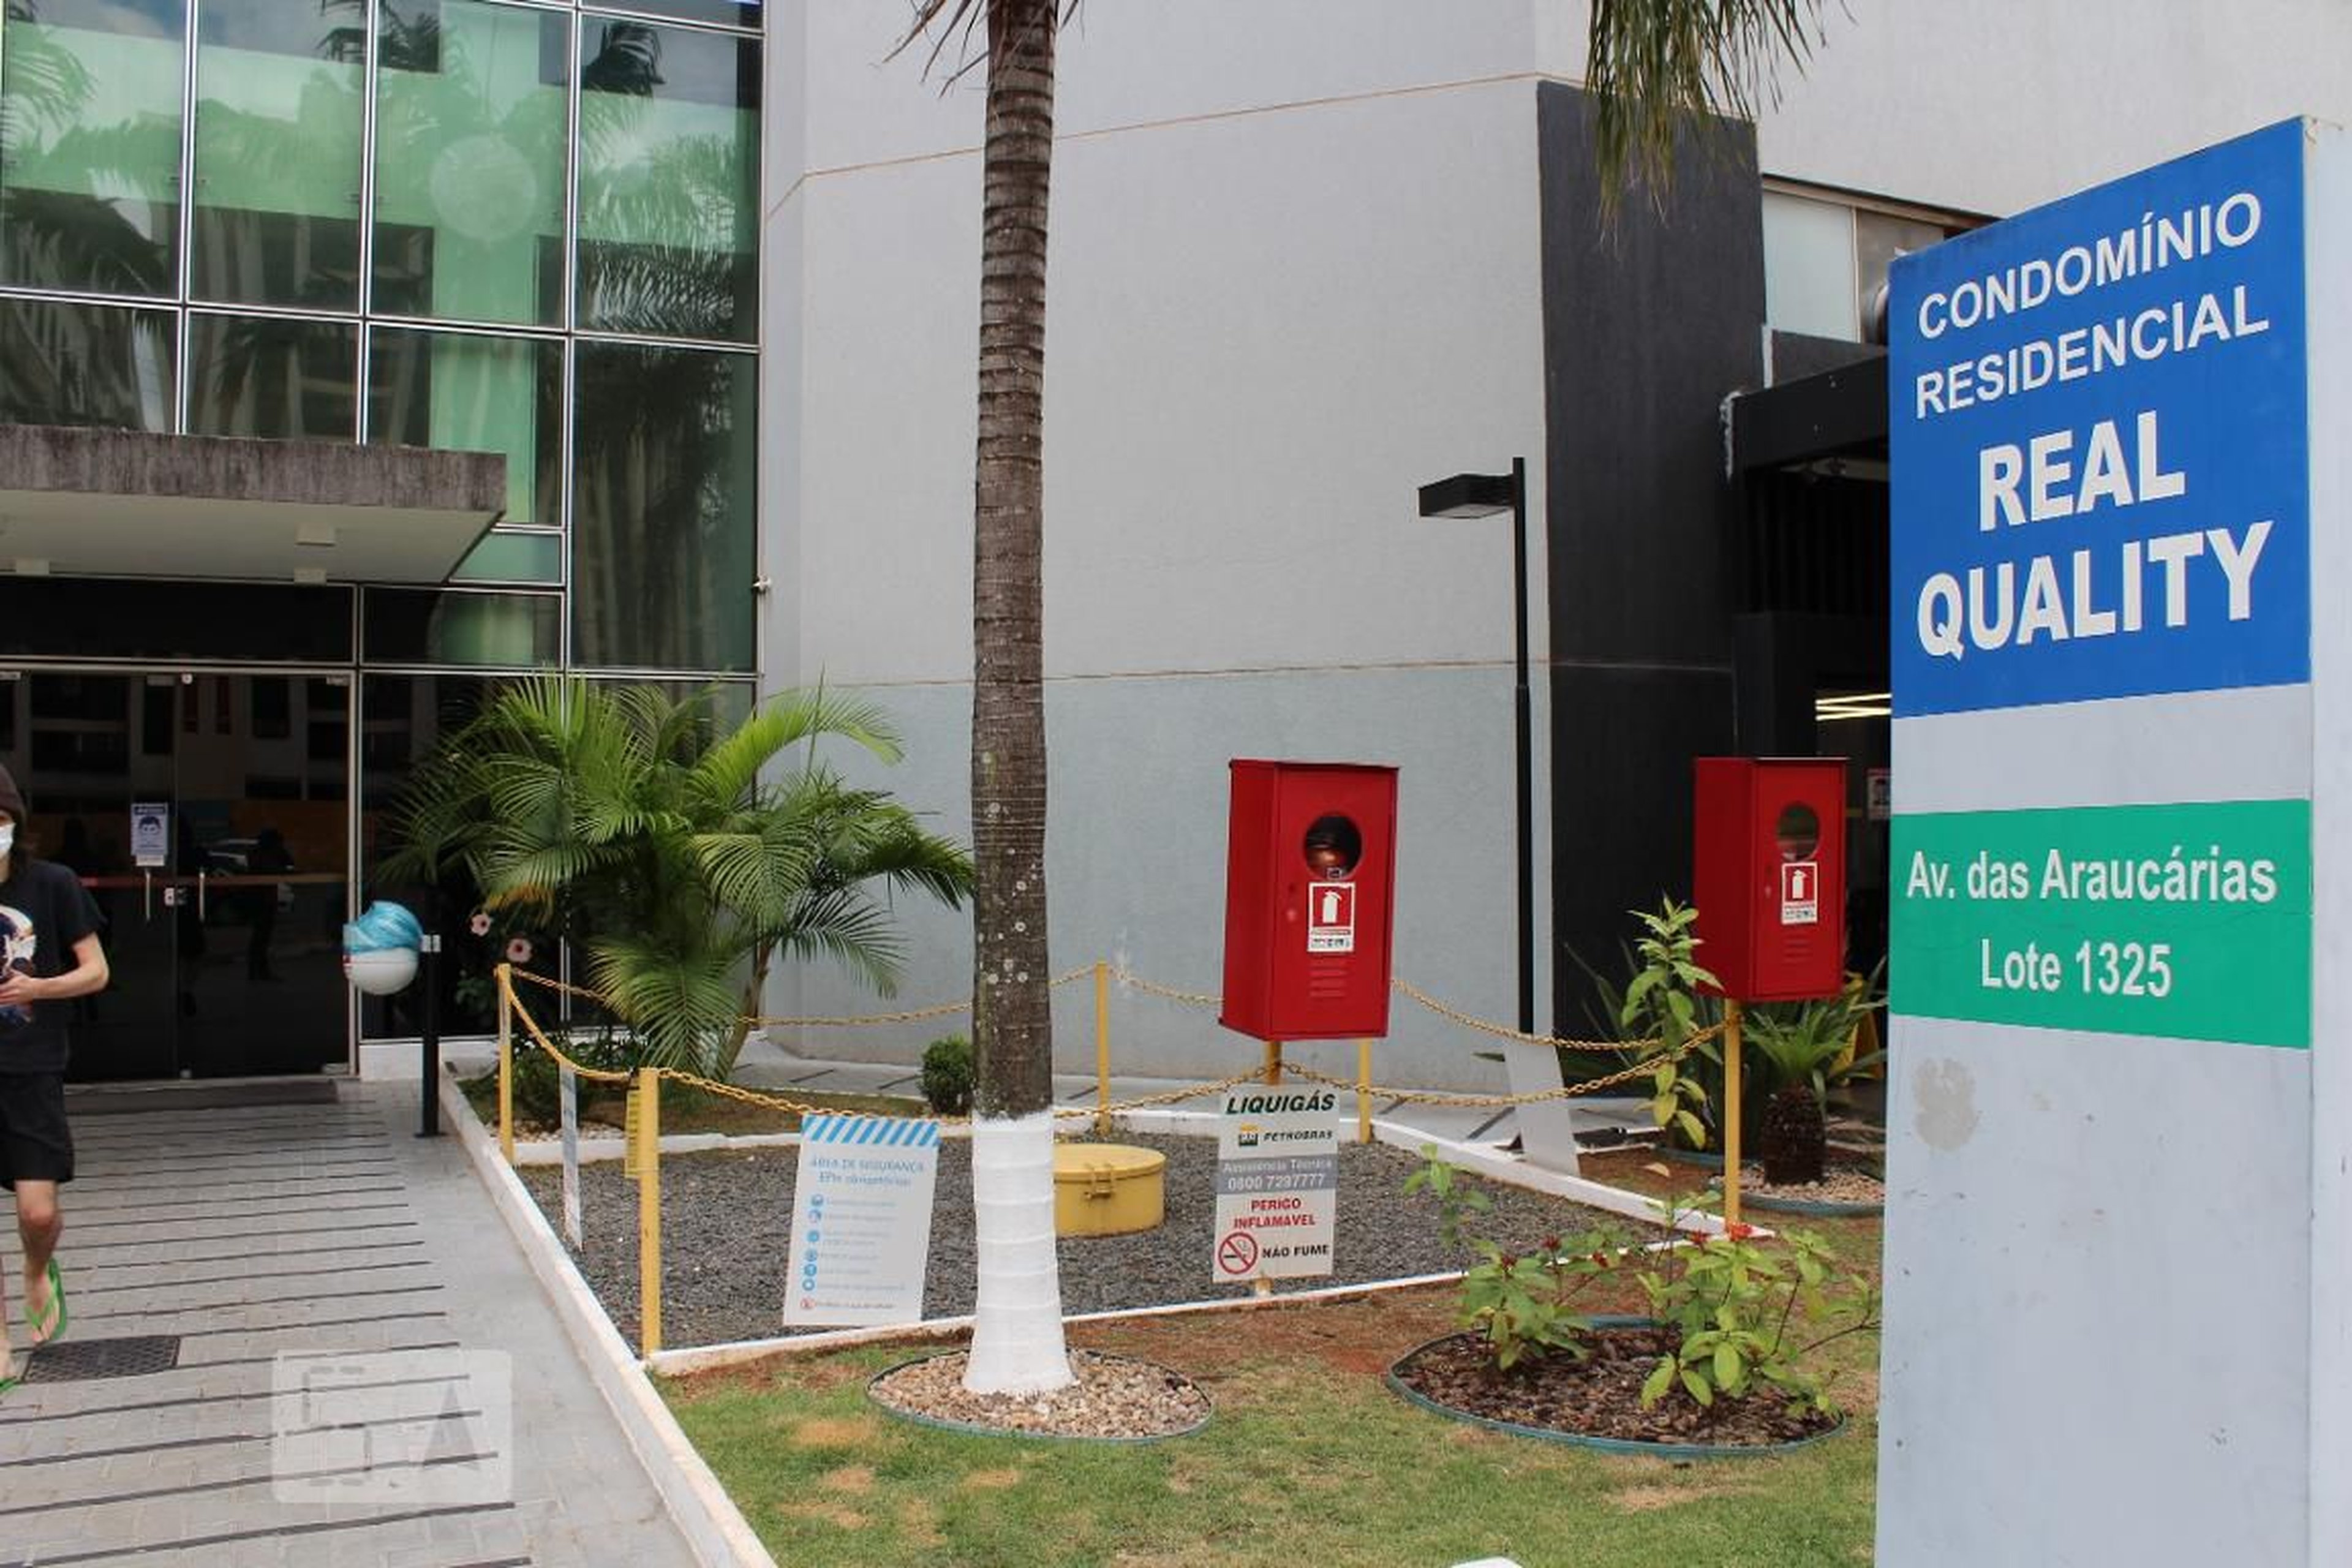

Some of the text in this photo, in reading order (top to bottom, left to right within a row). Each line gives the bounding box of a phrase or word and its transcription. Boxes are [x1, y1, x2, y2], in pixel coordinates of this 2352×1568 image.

[1918, 192, 2263, 340] CONDOMÍNIO
[1915, 284, 2270, 419] RESIDENCIAL
[1979, 410, 2186, 532] REAL
[1917, 520, 2274, 661] QUALITY
[1906, 845, 2278, 903] Av. das Araucárias
[1981, 939, 2173, 998] Lote 1325
[1226, 1089, 1336, 1115] LIQUIGÁS
[1263, 1130, 1333, 1142] PETROBRAS
[1227, 1175, 1263, 1191] 0800
[1251, 1197, 1302, 1212] PERIGO
[1294, 1244, 1330, 1256] FUME
